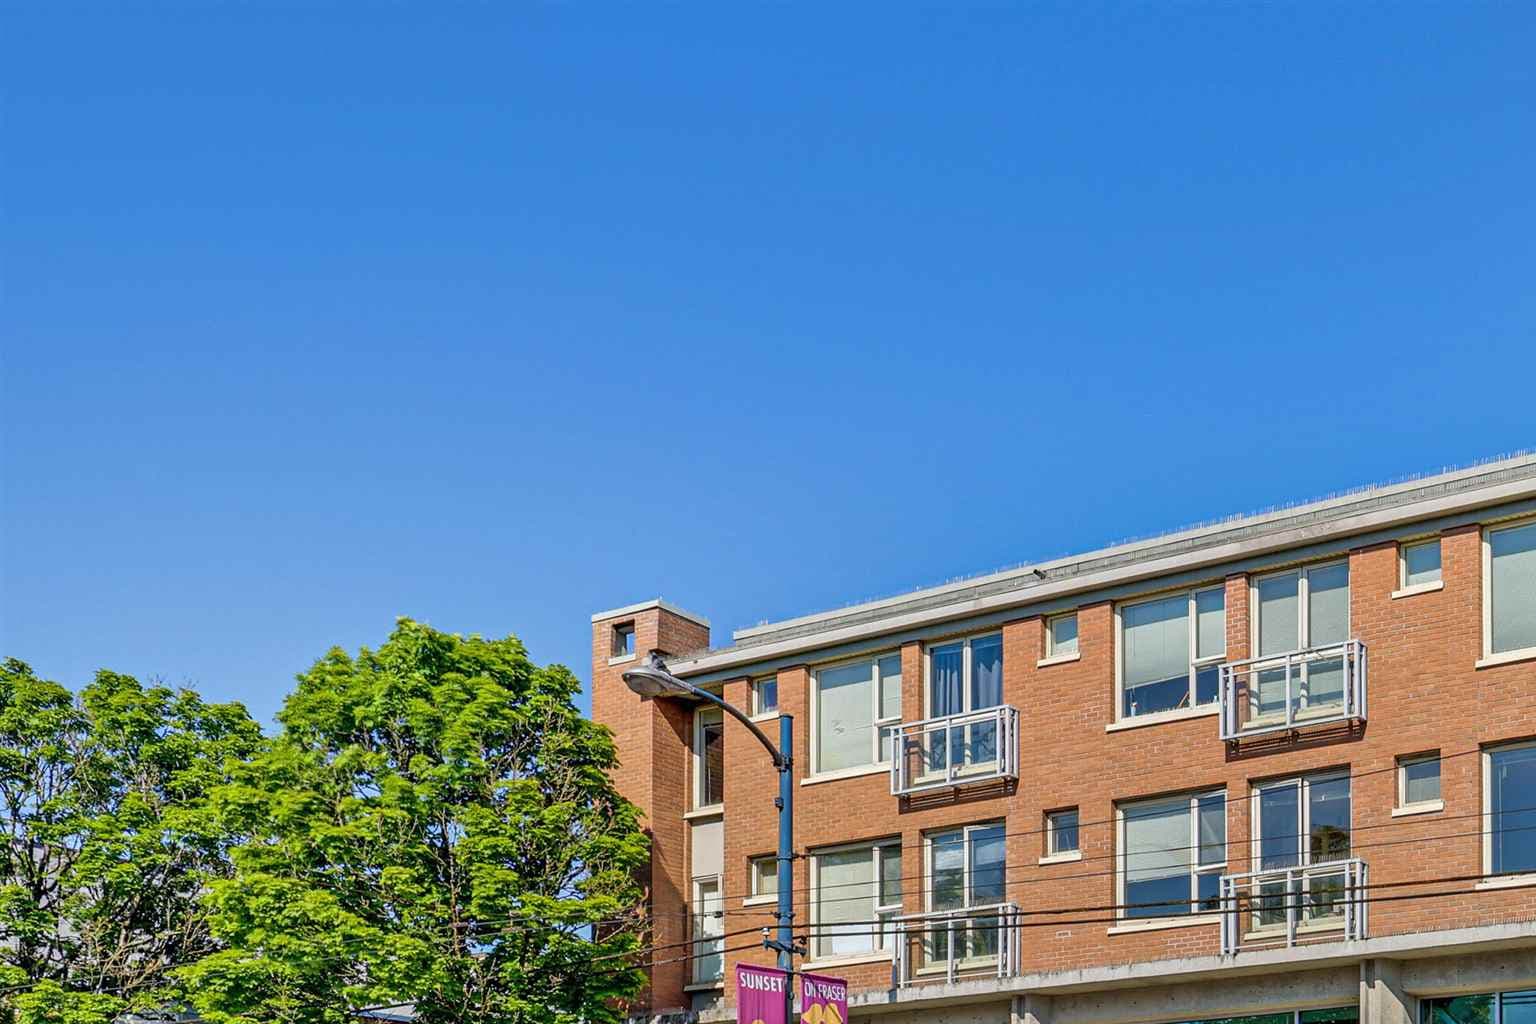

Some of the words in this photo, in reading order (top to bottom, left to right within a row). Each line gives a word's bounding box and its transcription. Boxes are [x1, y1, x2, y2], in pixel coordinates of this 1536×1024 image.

[740, 972, 783, 992] SUNSET
[804, 981, 816, 998] ON
[818, 984, 846, 1001] FRASER
